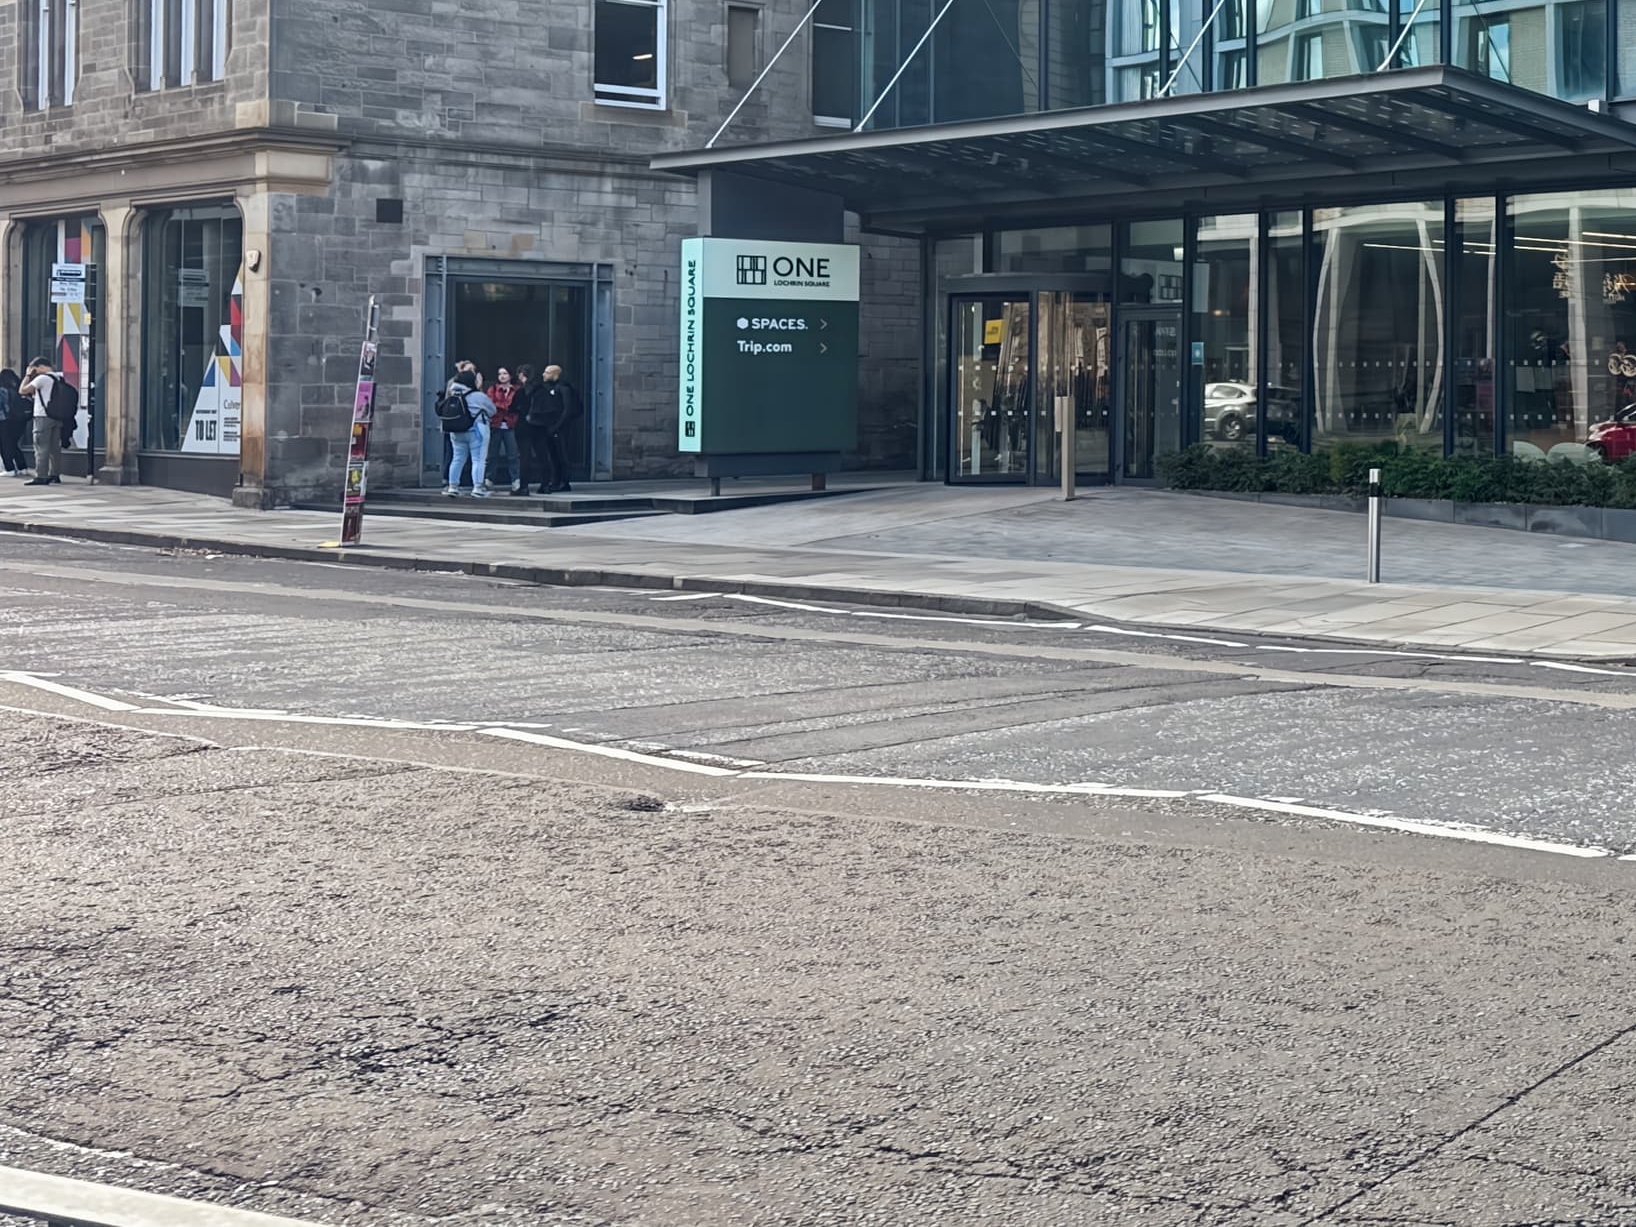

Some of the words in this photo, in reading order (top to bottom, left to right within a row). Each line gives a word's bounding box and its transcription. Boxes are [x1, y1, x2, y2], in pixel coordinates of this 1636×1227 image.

[773, 257, 830, 278] ONE
[688, 259, 697, 316] SQUARE
[687, 319, 696, 382] LOCHRIN
[737, 340, 793, 356] Trip.com
[686, 385, 695, 417] ONE
[195, 420, 204, 441] TO
[205, 420, 217, 441] LET
